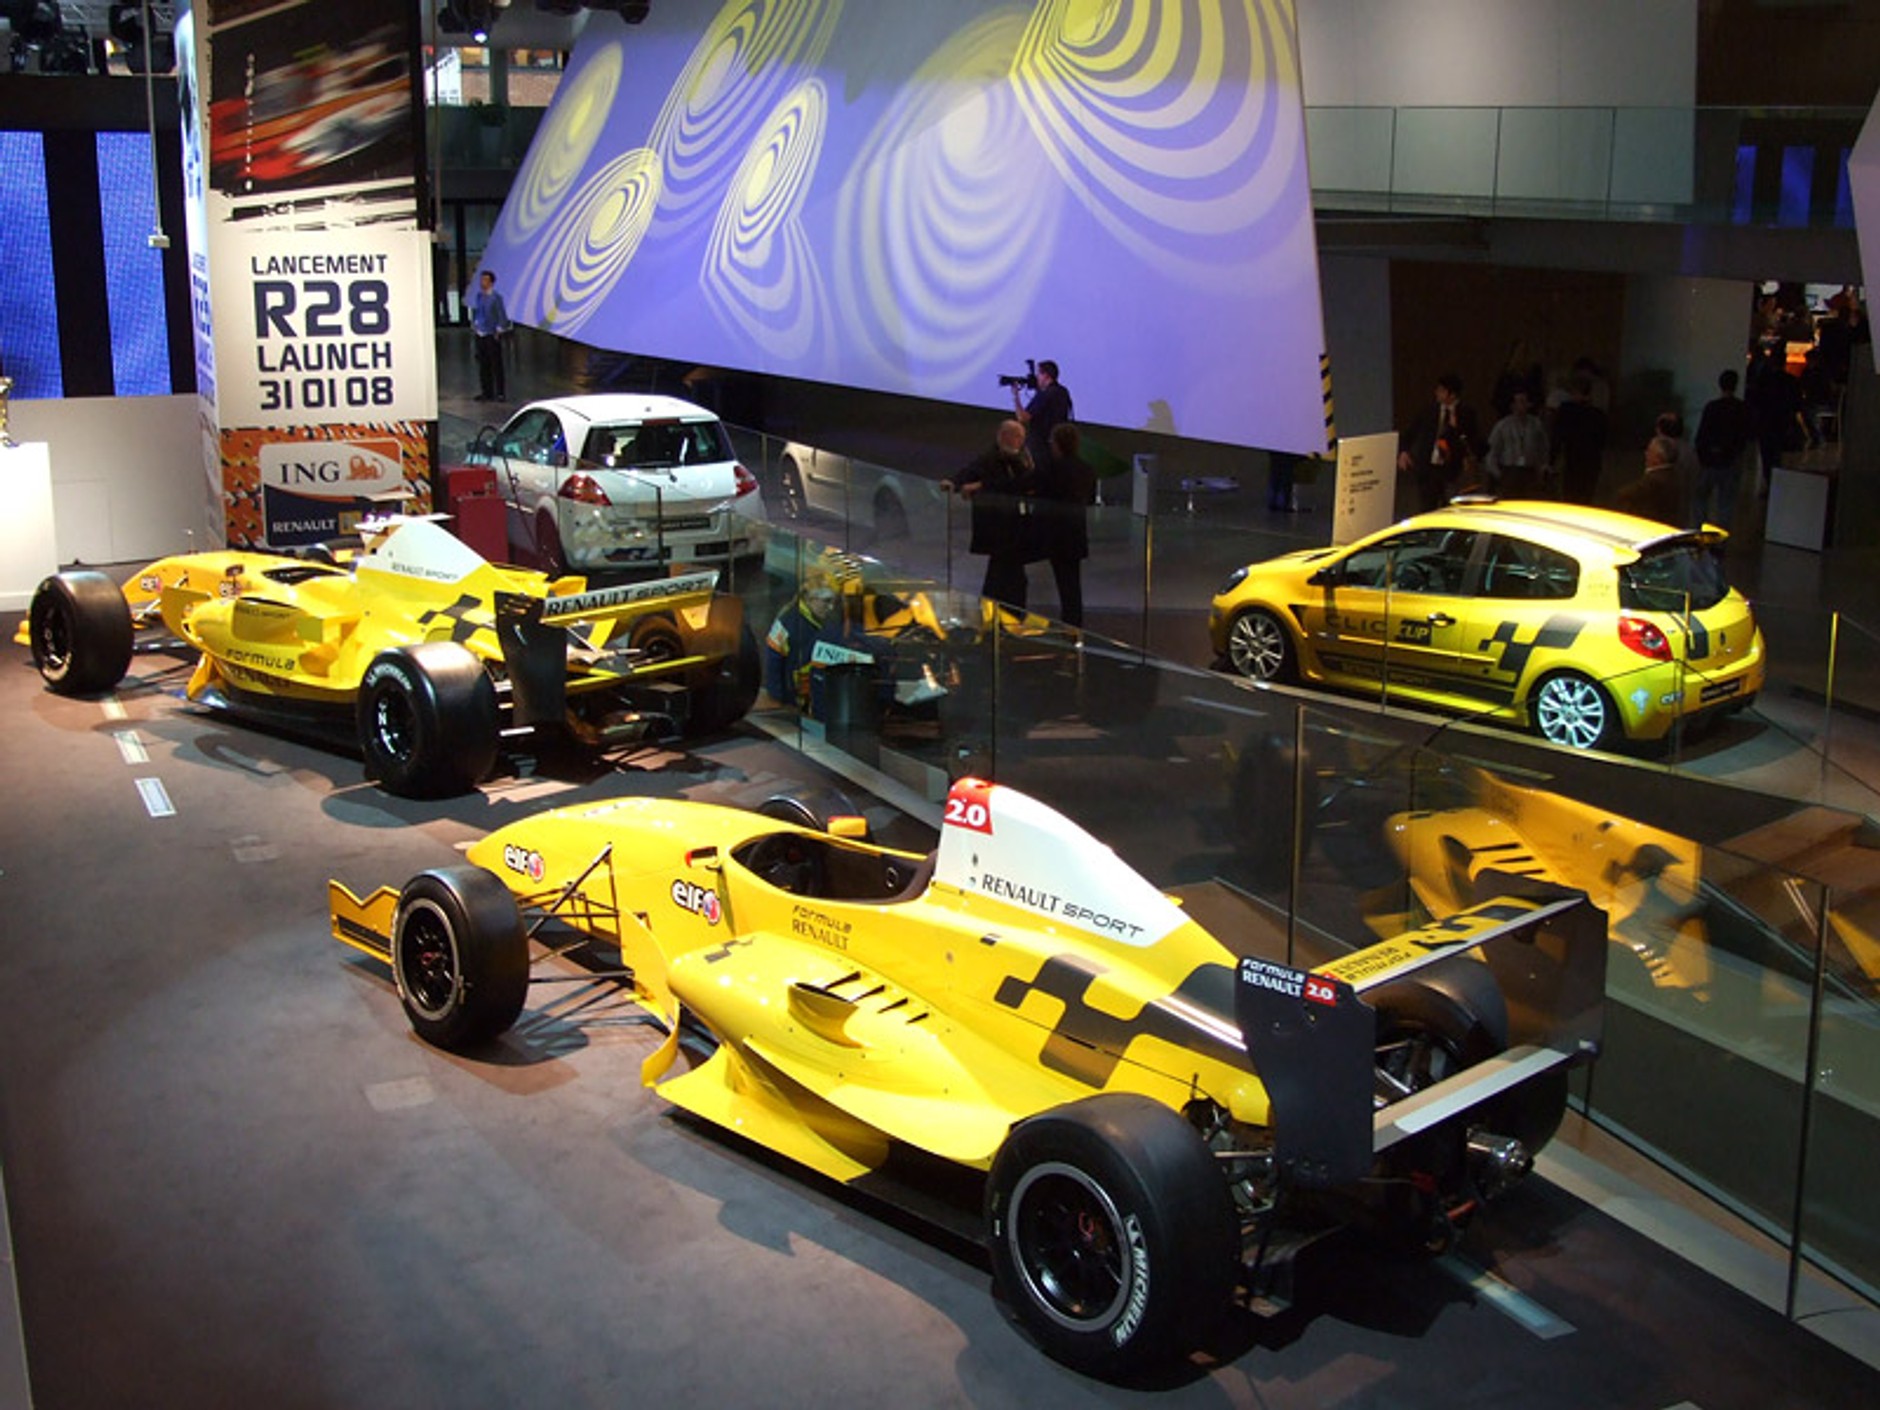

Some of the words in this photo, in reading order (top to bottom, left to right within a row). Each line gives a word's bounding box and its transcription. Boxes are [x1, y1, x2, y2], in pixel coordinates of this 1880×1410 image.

[251, 254, 388, 276] LANCEMENT
[253, 279, 391, 339] R28
[256, 341, 392, 373] LAUNCH
[279, 460, 341, 484] ING
[272, 518, 337, 533] RENAULT
[549, 590, 633, 614] RENAULT
[945, 799, 987, 827] 2.0
[671, 880, 704, 914] elf
[982, 873, 1061, 913] RENAULT
[1062, 901, 1144, 938] SPORT
[792, 919, 849, 951] RENAULT
[1242, 969, 1303, 997] RENAULT
[1308, 982, 1334, 1000] 2.0
[1115, 1249, 1149, 1343] MICHELIN
